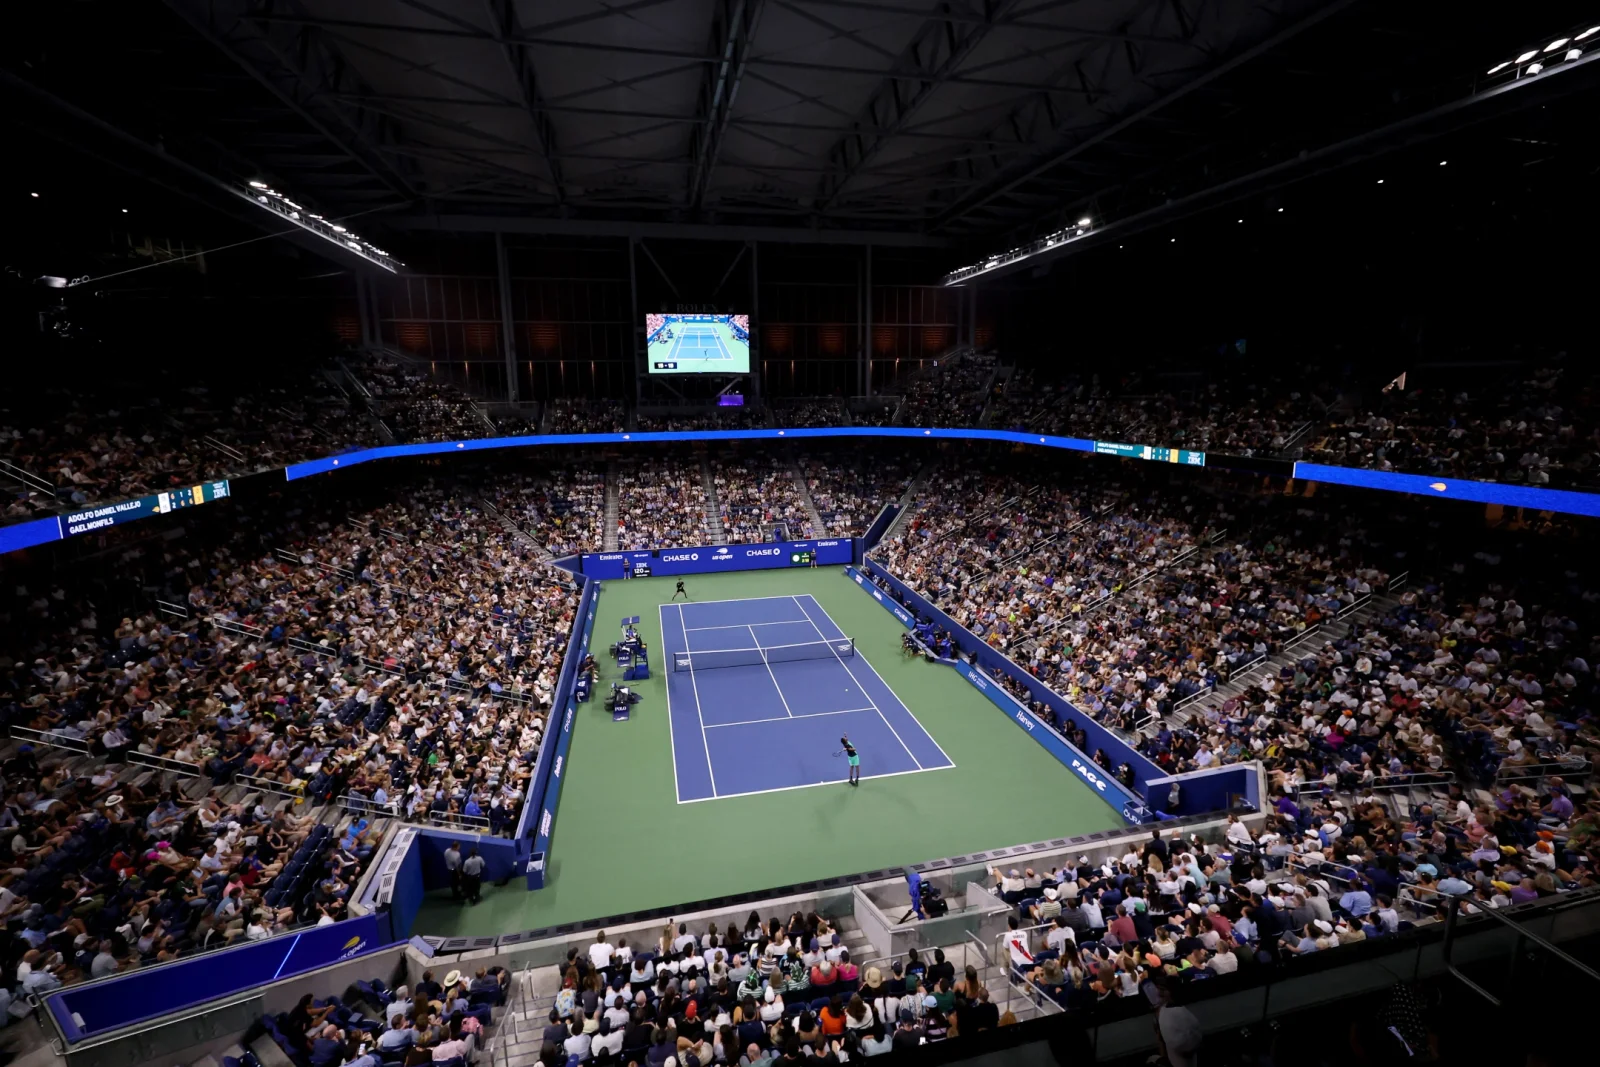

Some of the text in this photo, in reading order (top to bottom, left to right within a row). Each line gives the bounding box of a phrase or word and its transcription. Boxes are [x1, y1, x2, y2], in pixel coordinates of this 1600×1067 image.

[677, 303, 718, 313] ROLEX
[68, 510, 94, 524] ADOLFO
[94, 506, 116, 518] DANIEL
[116, 500, 141, 512] VALLEJO
[69, 524, 88, 534] GAEL
[87, 517, 114, 529] MONFILS
[663, 554, 690, 562] CHASE
[564, 708, 573, 732] CHUBB
[1016, 710, 1035, 731] Harvey
[1072, 759, 1106, 791] FAGE
